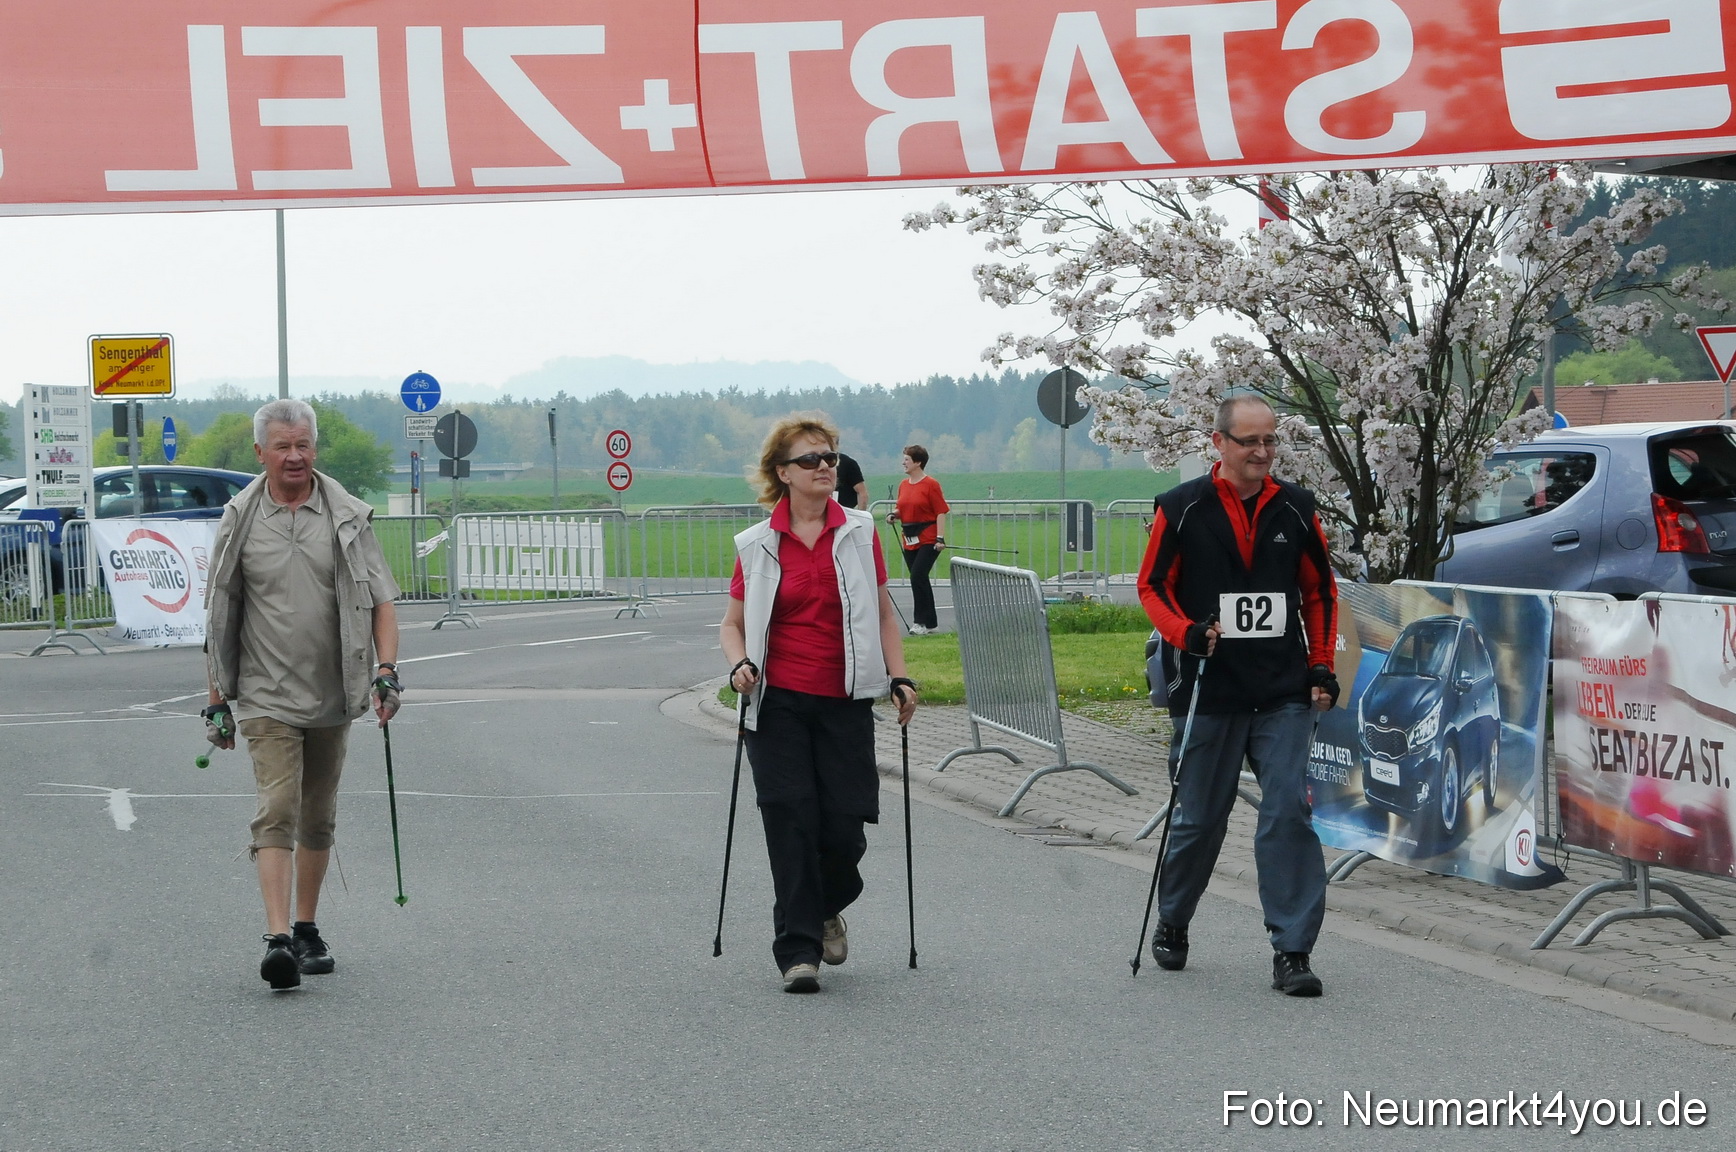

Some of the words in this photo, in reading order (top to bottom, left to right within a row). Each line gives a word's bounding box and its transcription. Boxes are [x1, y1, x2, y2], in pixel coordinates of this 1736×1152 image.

[99, 345, 163, 363] Sengenthal
[108, 365, 122, 373] am
[40, 428, 54, 444] SHB
[611, 437, 627, 452] 60
[41, 469, 63, 485] THULE
[109, 549, 171, 571] GERHART
[170, 554, 177, 565] &
[114, 571, 149, 582] Autohaus
[1235, 595, 1273, 633] 62
[122, 625, 160, 640] Neumarkt
[1581, 656, 1619, 676] FREIRAUM
[1619, 655, 1647, 677] FÜRS
[1576, 680, 1624, 720] LEBEN.
[1700, 738, 1730, 790] ST.
